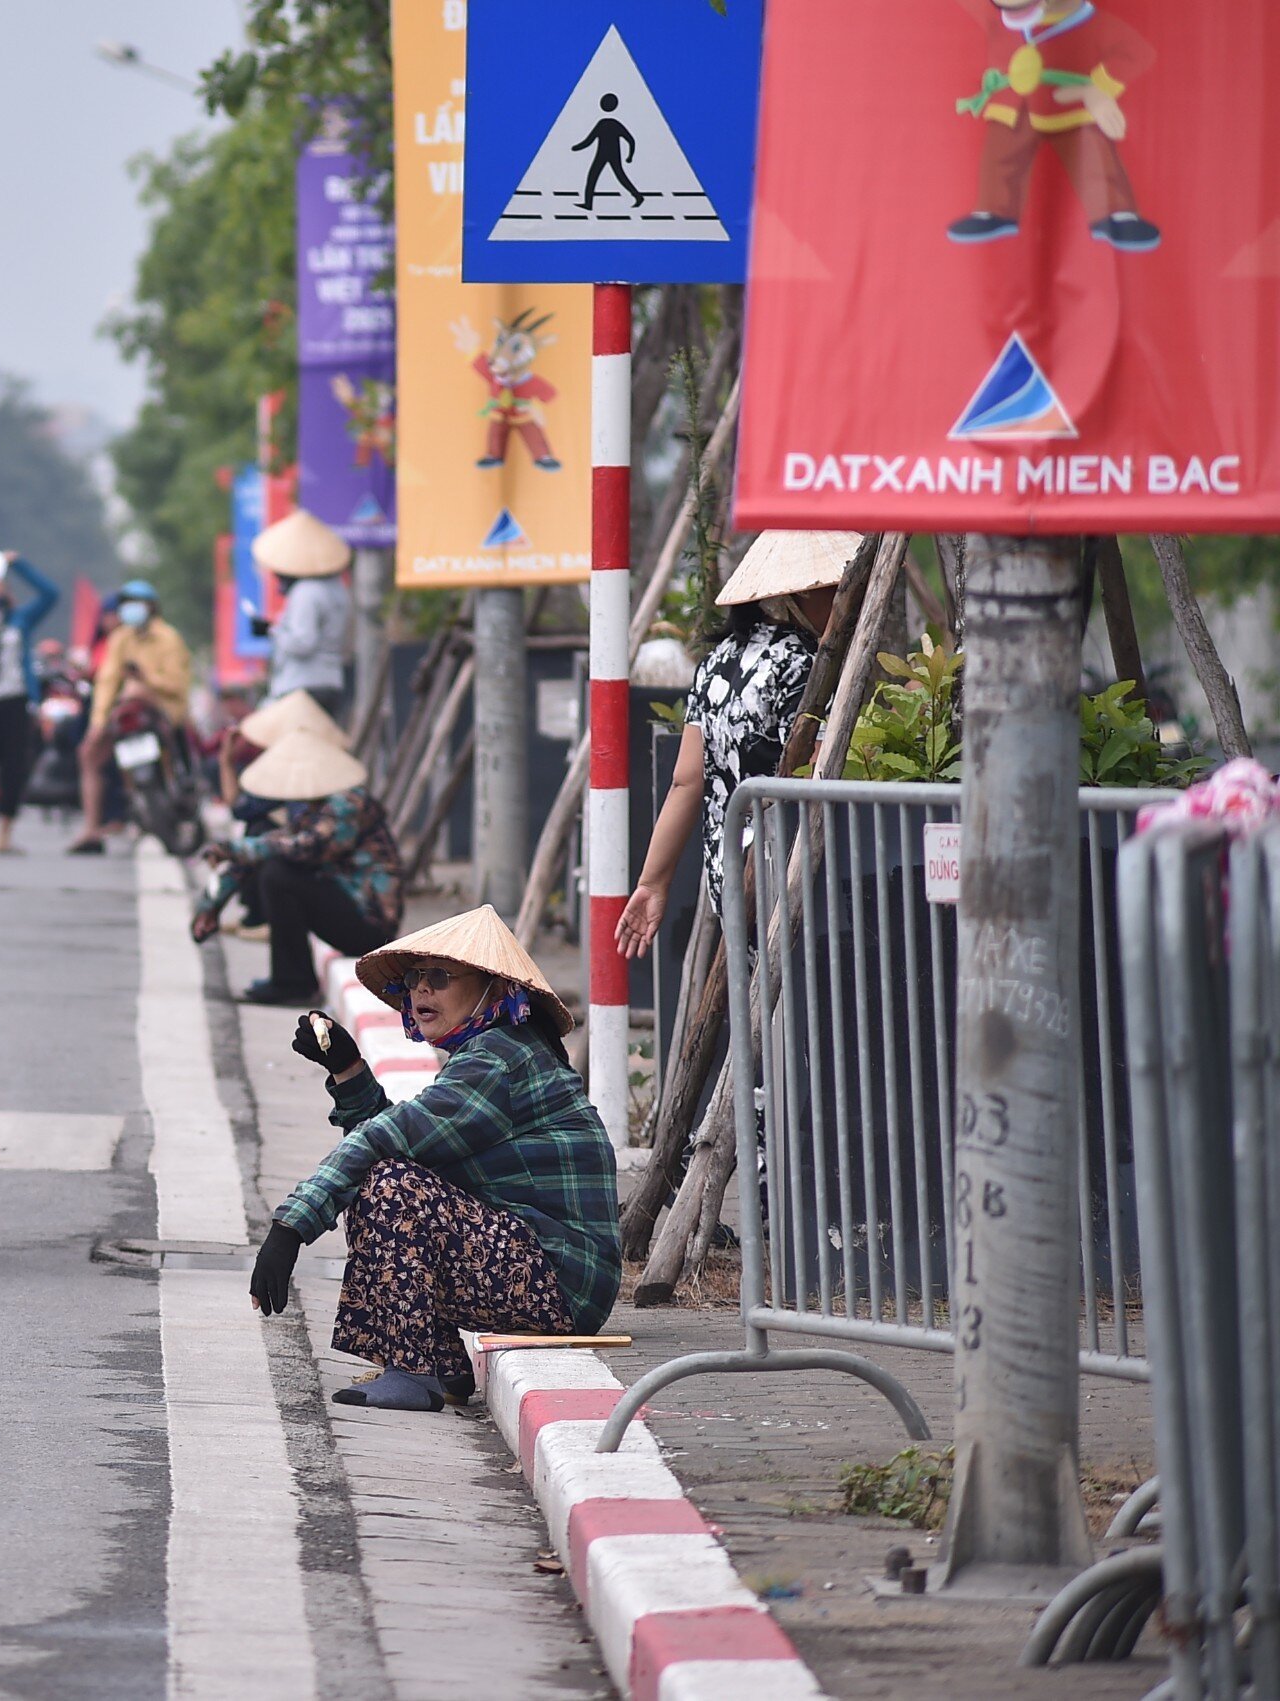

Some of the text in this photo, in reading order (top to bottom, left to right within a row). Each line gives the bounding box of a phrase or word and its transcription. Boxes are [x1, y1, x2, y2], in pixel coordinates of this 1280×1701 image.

[428, 162, 465, 195] VI
[783, 453, 1240, 494] DATXANH MIEN BAC
